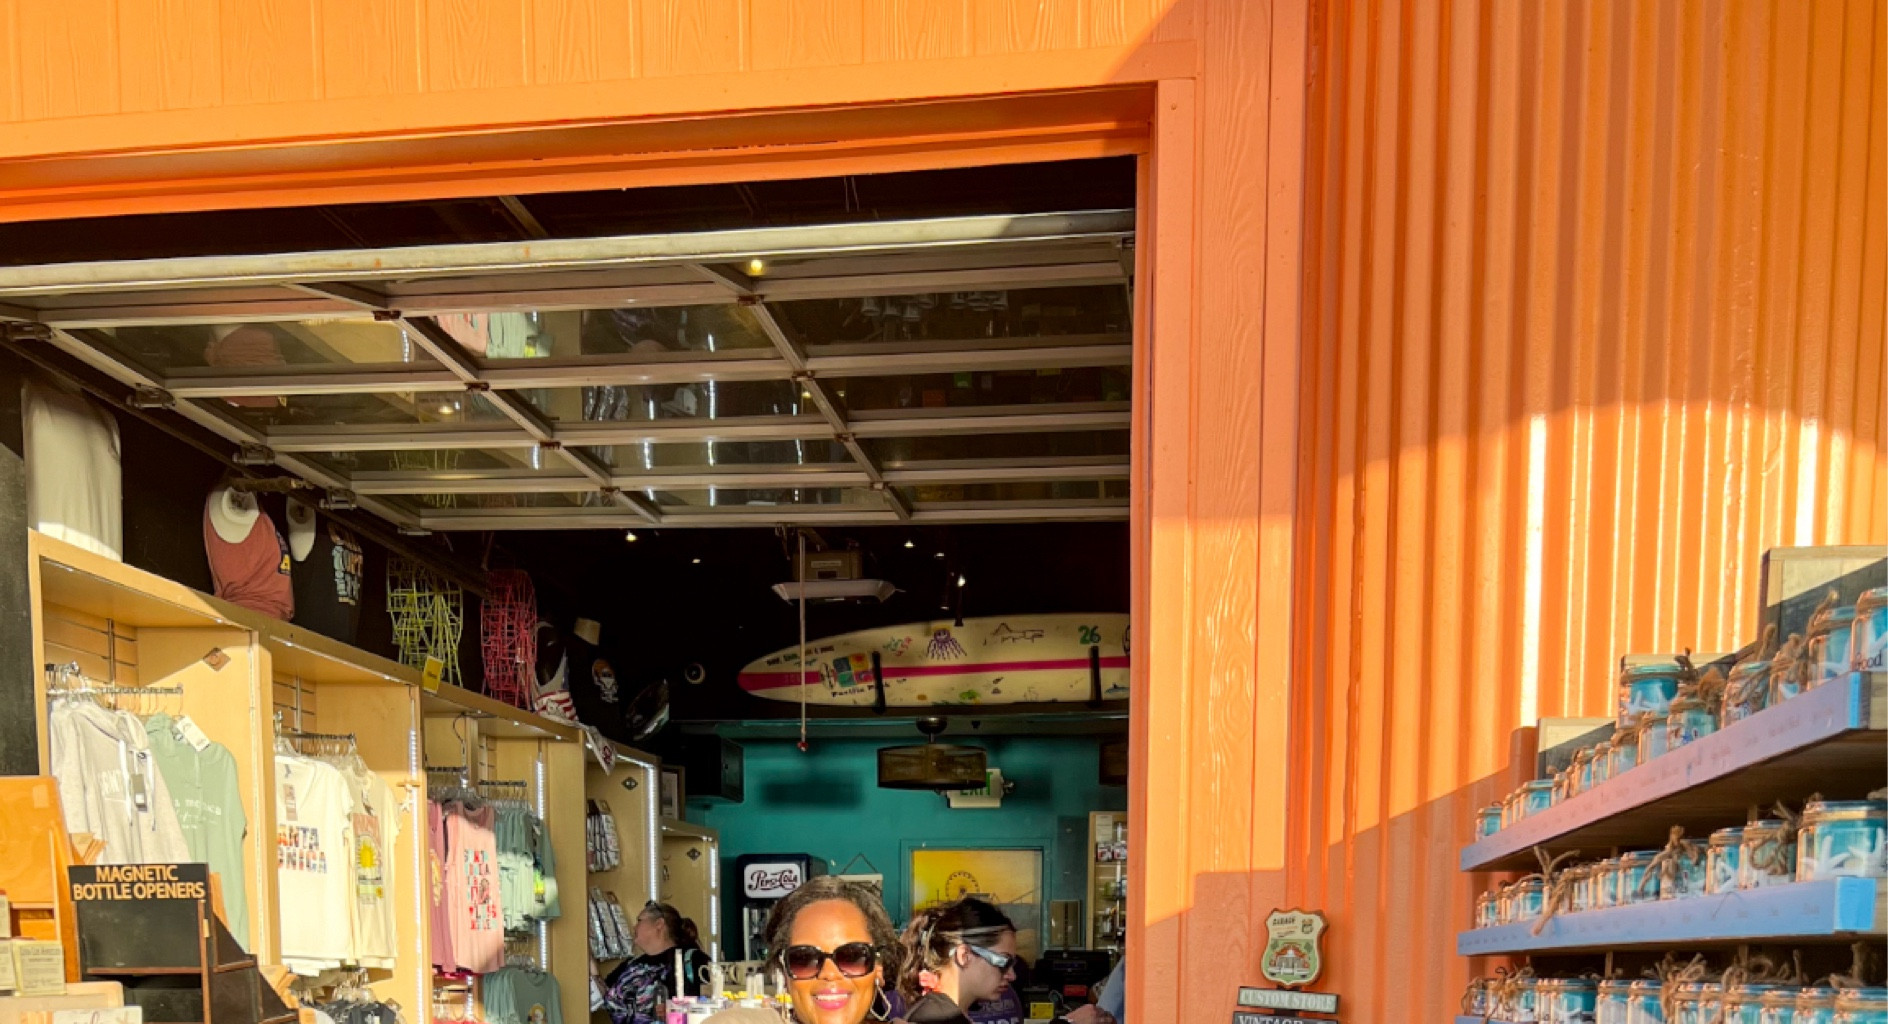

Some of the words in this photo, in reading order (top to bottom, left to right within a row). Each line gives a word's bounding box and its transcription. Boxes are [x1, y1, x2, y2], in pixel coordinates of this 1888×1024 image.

[1078, 625, 1101, 645] 26
[96, 865, 179, 883] MAGNETIC
[73, 883, 132, 901] BOTTLE
[133, 881, 206, 899] OPENERS
